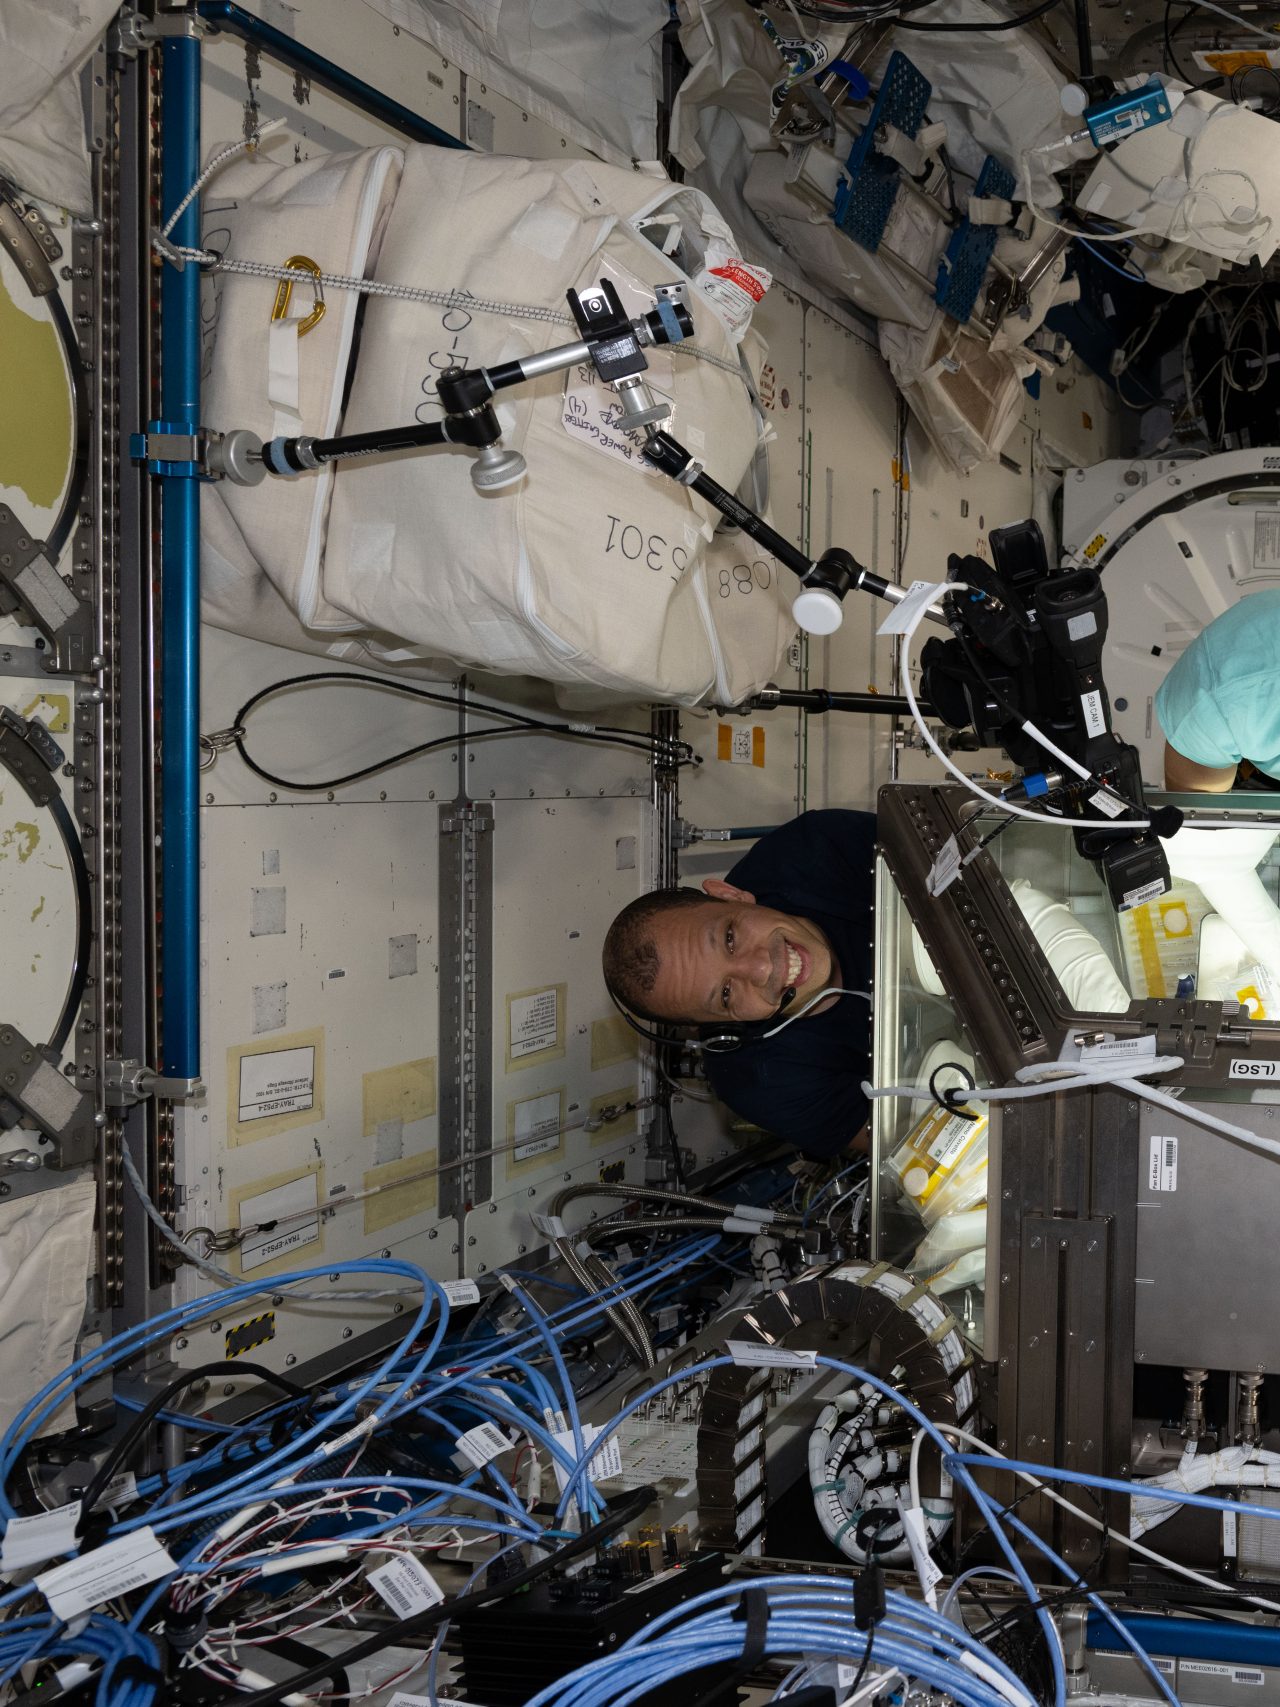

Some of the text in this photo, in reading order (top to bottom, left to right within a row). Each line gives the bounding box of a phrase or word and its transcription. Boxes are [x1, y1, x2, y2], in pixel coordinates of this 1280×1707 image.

[600, 432, 631, 458] POWER
[1086, 694, 1095, 707] JEM
[1089, 708, 1097, 722] CAM
[1231, 1060, 1276, 1076] (LSG)
[260, 1233, 300, 1255] TRAY-EPS2-2
